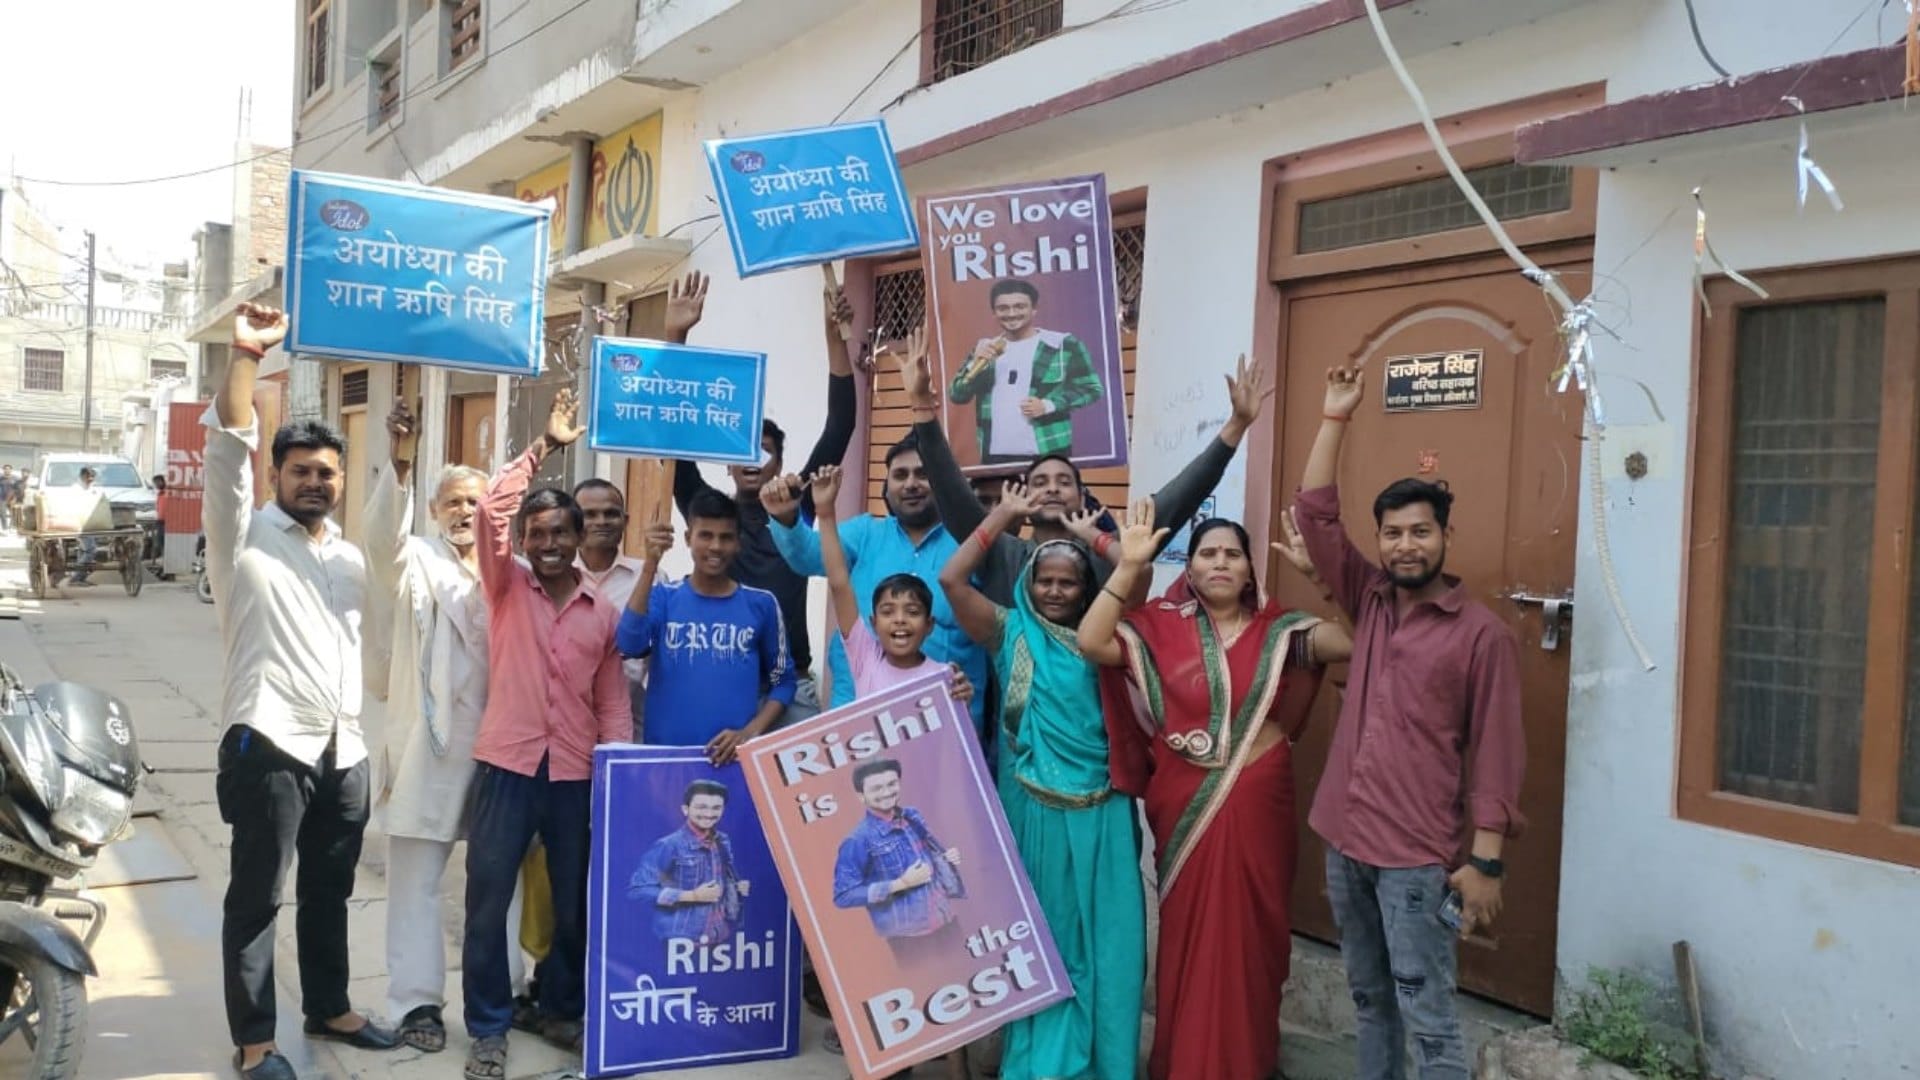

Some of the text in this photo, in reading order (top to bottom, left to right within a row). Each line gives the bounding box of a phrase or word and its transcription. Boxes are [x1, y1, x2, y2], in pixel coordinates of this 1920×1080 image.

[751, 155, 869, 197] अयोध्या की
[331, 209, 365, 230] Idol
[752, 188, 888, 230] शान ऋषि सिंह
[934, 197, 1092, 232] We love
[334, 230, 508, 284] अयोध्या की
[939, 231, 982, 250] you
[952, 233, 1090, 283] Rishi
[326, 279, 517, 327] शान ऋषि सिंह
[1389, 353, 1477, 378] राजेन्द्र सिंह
[620, 370, 736, 402] अयोध्या की
[615, 401, 742, 430] शान ऋषि सिंह
[665, 621, 755, 652] TRUE
[774, 697, 943, 786] Rishi
[795, 793, 838, 824] is
[667, 930, 775, 976] Rishi
[965, 920, 1031, 958] the
[609, 974, 776, 1027] जीत के आना
[863, 946, 1040, 1050] Best
